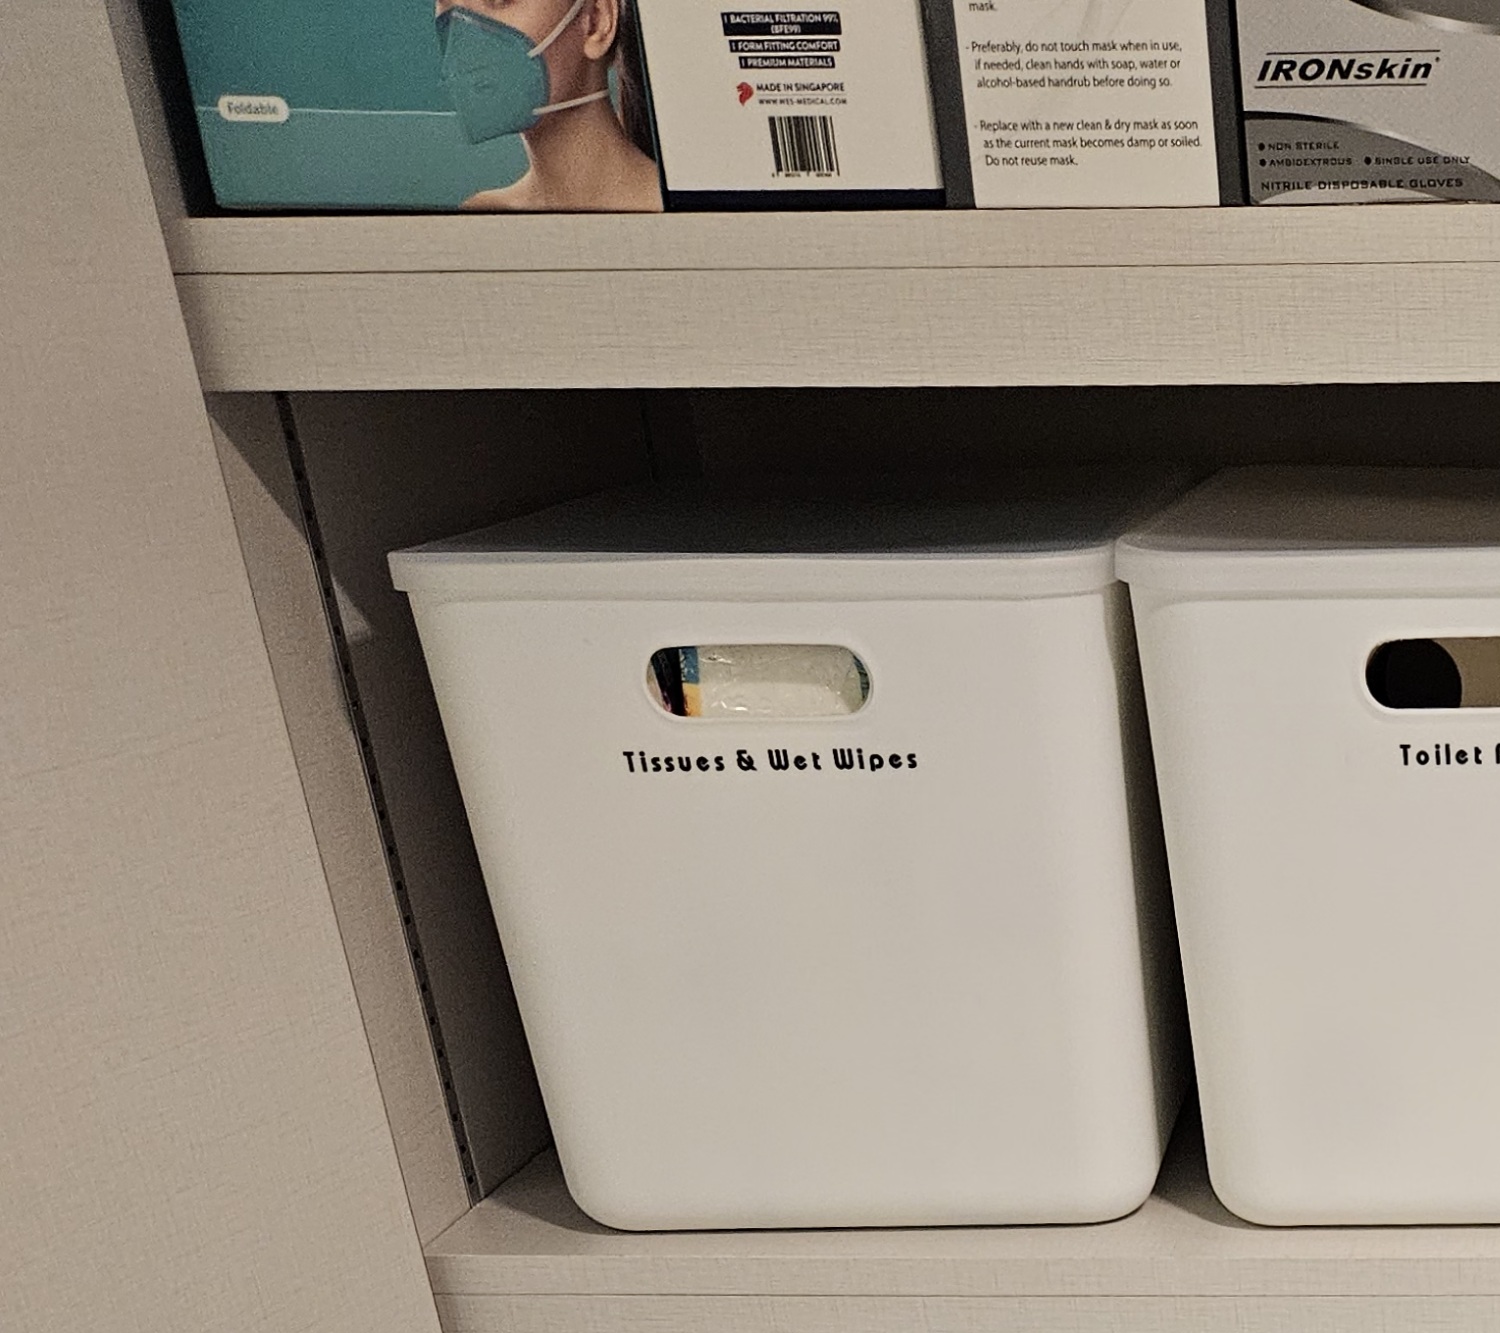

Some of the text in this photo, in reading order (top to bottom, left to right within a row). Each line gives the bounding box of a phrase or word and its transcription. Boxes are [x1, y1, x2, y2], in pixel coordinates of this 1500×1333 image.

[969, 1, 997, 11] mask.
[738, 41, 838, 50] FORM FITTING COMFORT
[971, 40, 1182, 54] Preferably, do not touch mask when in use,
[747, 58, 832, 66] PREMIUM MATERIALS
[975, 58, 1180, 72] if needed, clean hands with soap, water or
[1255, 56, 1434, 82] IRONskin
[757, 83, 844, 91] MADE IN SINGAPORE
[977, 77, 1172, 90] alcohol-based handrub before doing so.
[226, 102, 280, 115] Foldable
[980, 120, 1198, 132] Replace with a new clean & dry mask as soon
[983, 137, 1202, 150] as the current mask becomes damp or soiled.
[1268, 141, 1340, 151] NON STERILE
[985, 155, 1078, 166] Do not reuse mask.
[1374, 155, 1470, 166] SINGLE USE ONLY
[1261, 178, 1463, 191] NITRILE DISPOSABLE GLOVES
[623, 748, 918, 772] Tissues & Wet Wipes
[1400, 744, 1483, 766] Toilet
